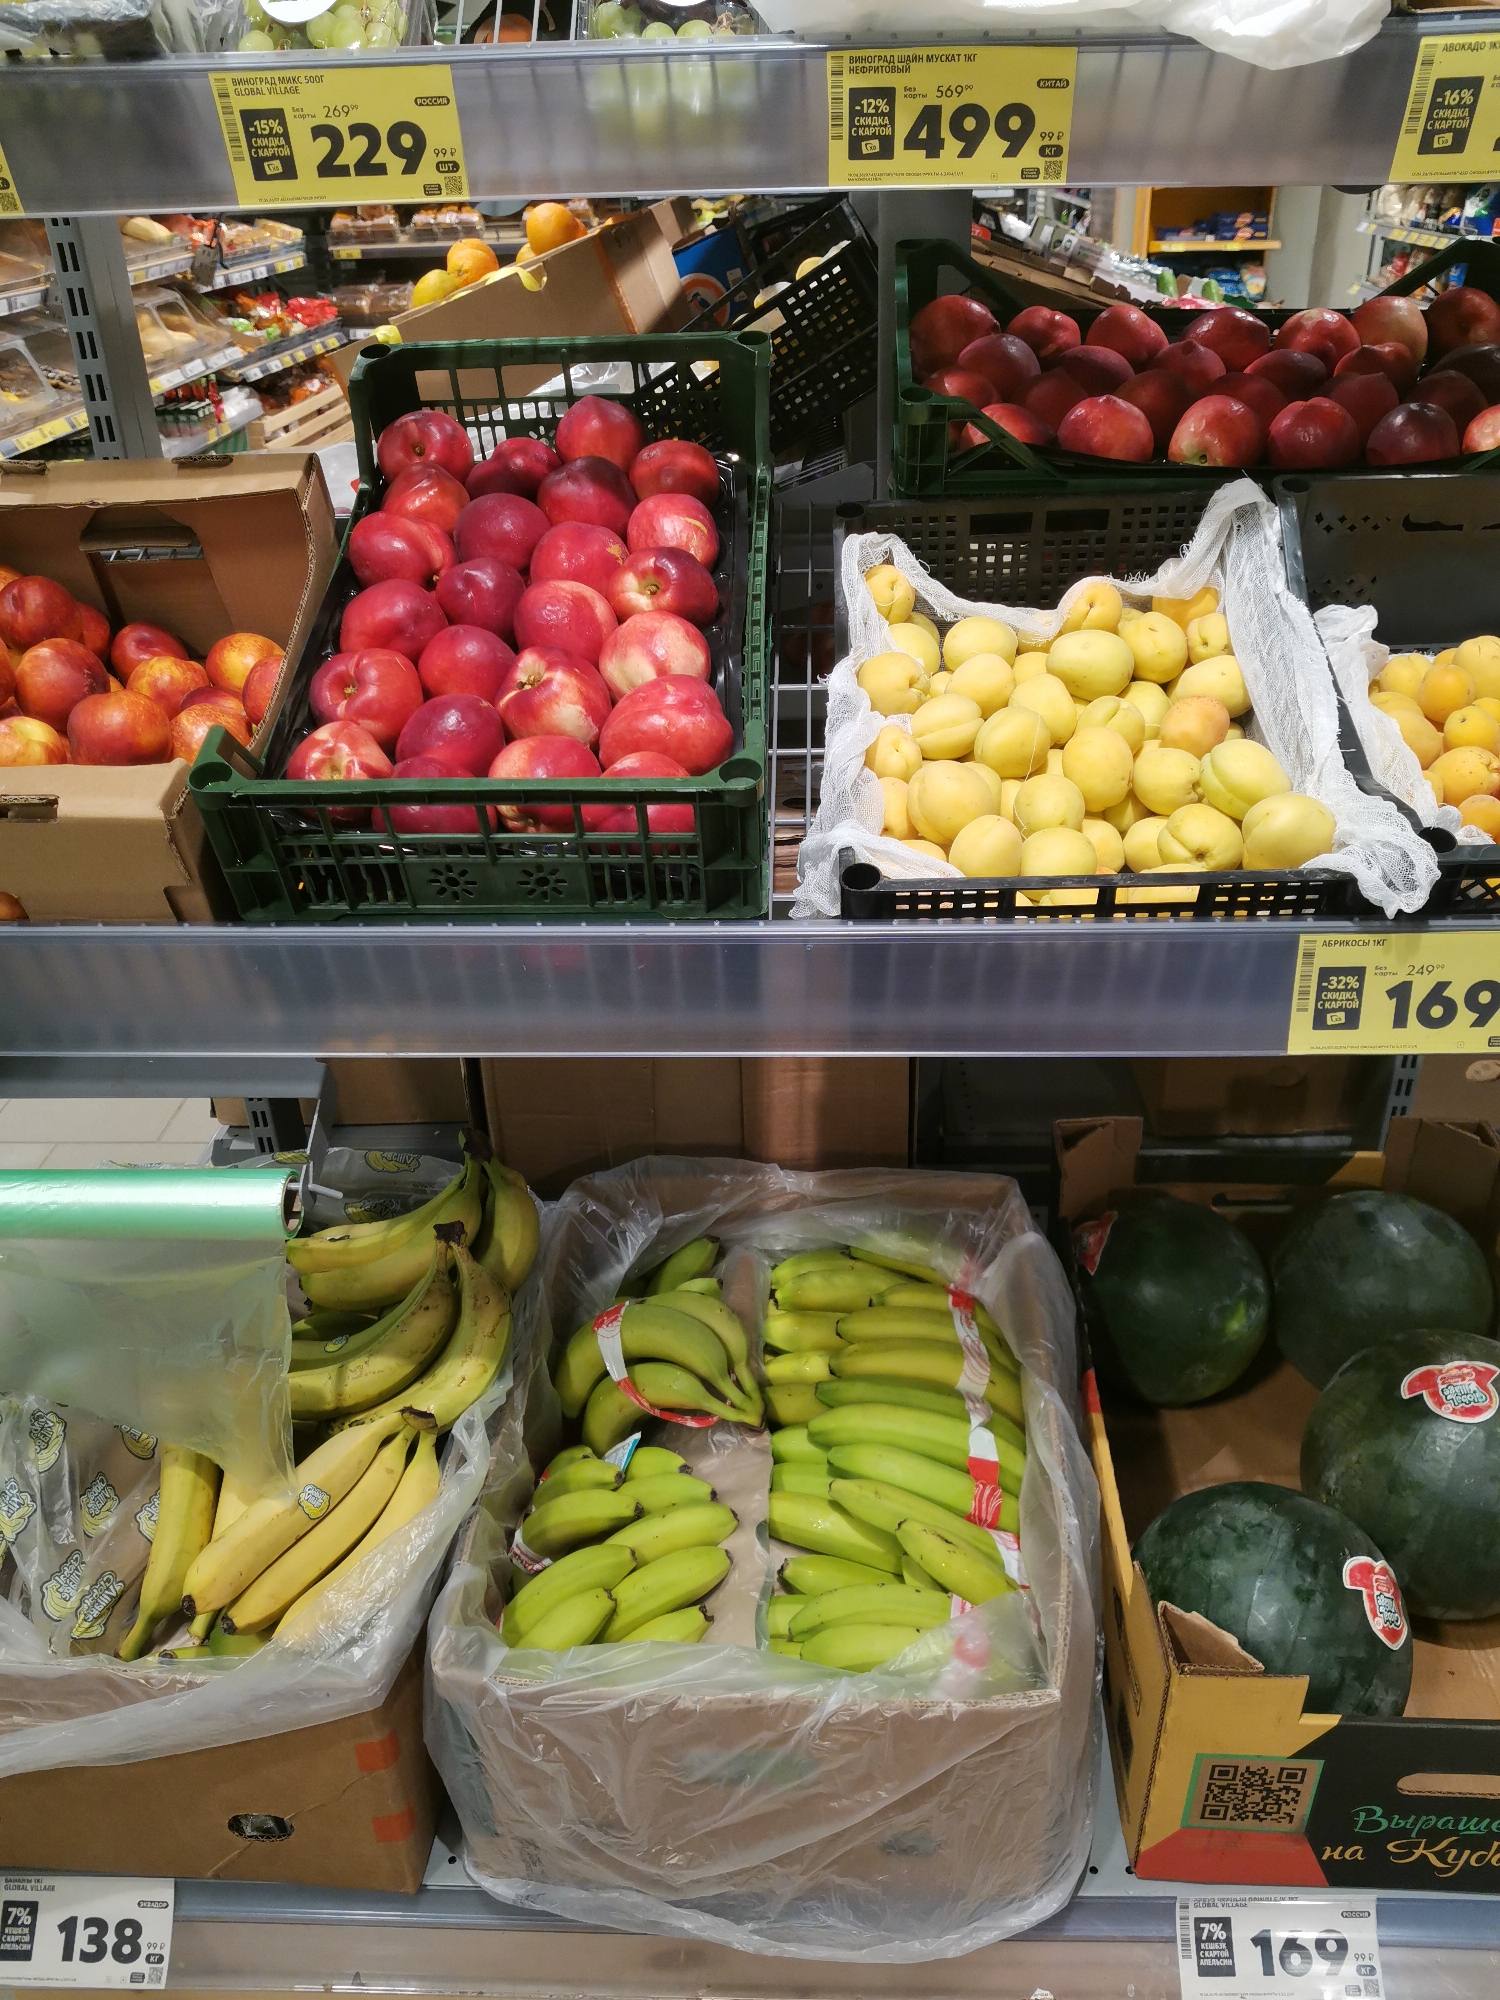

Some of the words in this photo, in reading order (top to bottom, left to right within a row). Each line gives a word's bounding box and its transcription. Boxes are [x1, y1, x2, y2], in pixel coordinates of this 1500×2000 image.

[1441, 41, 1486, 53] АВОКАДО
[1488, 40, 1500, 50] 1К
[848, 55, 895, 65] ВИНОГРАД
[897, 54, 924, 64] ШАЙН
[926, 54, 961, 64] МУСКАТ
[964, 53, 978, 62] 1КГ
[848, 62, 911, 74] НЕФРИТОВЫЙ
[231, 76, 276, 87] ВИНОГРАД
[278, 75, 302, 85] МИКС
[304, 74, 324, 84] 500Г
[1040, 78, 1067, 88] КИТАЙ
[234, 86, 266, 96] GLOBAL
[267, 86, 300, 96] VILLAGE
[904, 92, 928, 100] карты
[1436, 88, 1474, 106] -16%
[416, 97, 448, 106] РОССИЯ
[854, 98, 890, 114] -12%
[1432, 108, 1470, 119] СКИДКА
[248, 118, 284, 135] -15%
[854, 116, 890, 127] СКИДКА
[1426, 120, 1434, 130] С
[1434, 116, 1470, 130] КАРТОЙ
[851, 128, 858, 136] С
[858, 124, 892, 136] КАРТОЙ
[903, 102, 1036, 159] 499
[251, 136, 286, 147] СКИДКА
[1040, 131, 1054, 142] 99
[251, 149, 258, 158] С
[258, 145, 290, 158] КАРТОЙ
[310, 120, 427, 178] 229
[433, 148, 448, 158] 99
[1045, 148, 1057, 156] КГ
[1321, 939, 1371, 948] АБРИКОСЫ
[1372, 938, 1388, 947] 1КГ
[1321, 976, 1360, 990] -32%
[1322, 991, 1358, 1001] СКИДКА
[1317, 1000, 1324, 1010] С
[1324, 998, 1360, 1009] КАРТОЙ
[1385, 979, 1500, 1030] 169
[1321, 1844, 1366, 1862] на
[4, 1884, 30, 1892] GLOBAL
[30, 1884, 56, 1892] VILLAGE
[7, 1907, 32, 1926] 7%
[1200, 1922, 1227, 1940] 7%
[57, 1916, 143, 1964] 138
[146, 1942, 158, 1950] 99
[1200, 1950, 1204, 1958] С
[1204, 1949, 1230, 1958] КАРТОЙ
[1250, 1928, 1349, 1978] 169
[1354, 1952, 1366, 1962] 99
[1200, 1958, 1233, 1966] АПЕЛЬСИН
